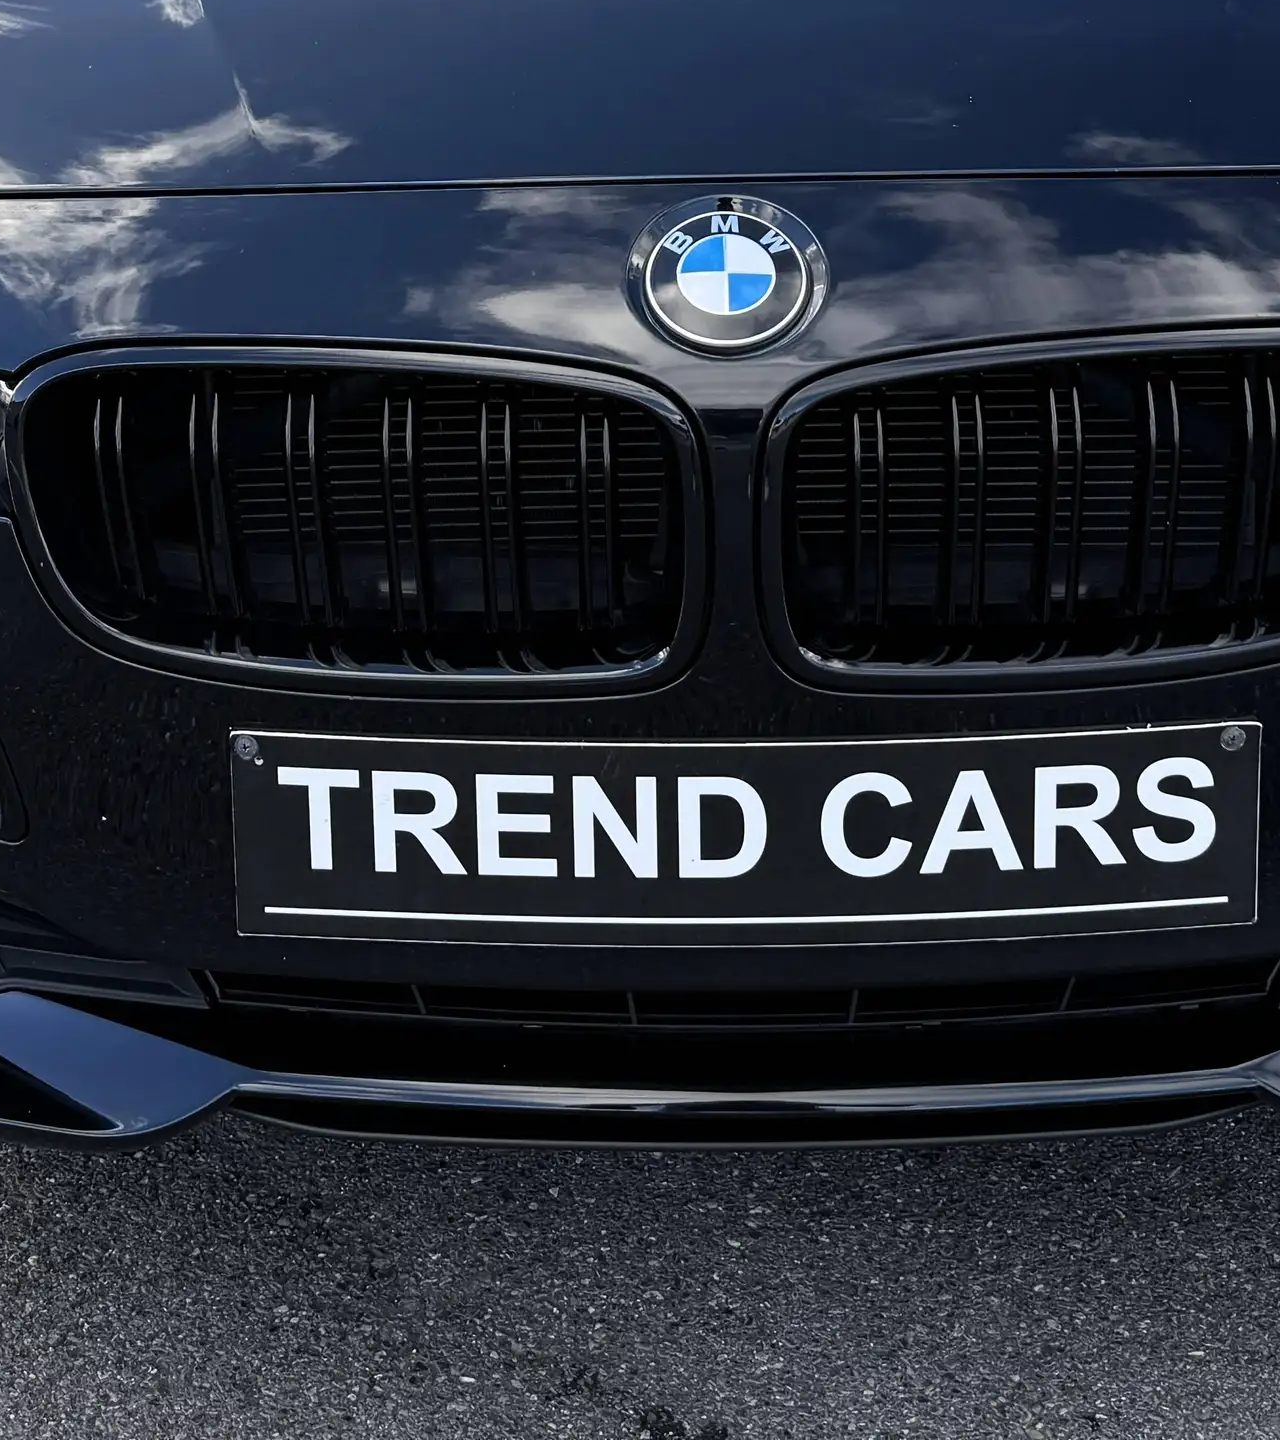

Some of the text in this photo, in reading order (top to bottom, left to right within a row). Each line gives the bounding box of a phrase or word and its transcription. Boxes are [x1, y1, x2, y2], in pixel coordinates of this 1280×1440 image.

[663, 215, 791, 255] BMW
[277, 756, 1216, 878] TREND CARS
